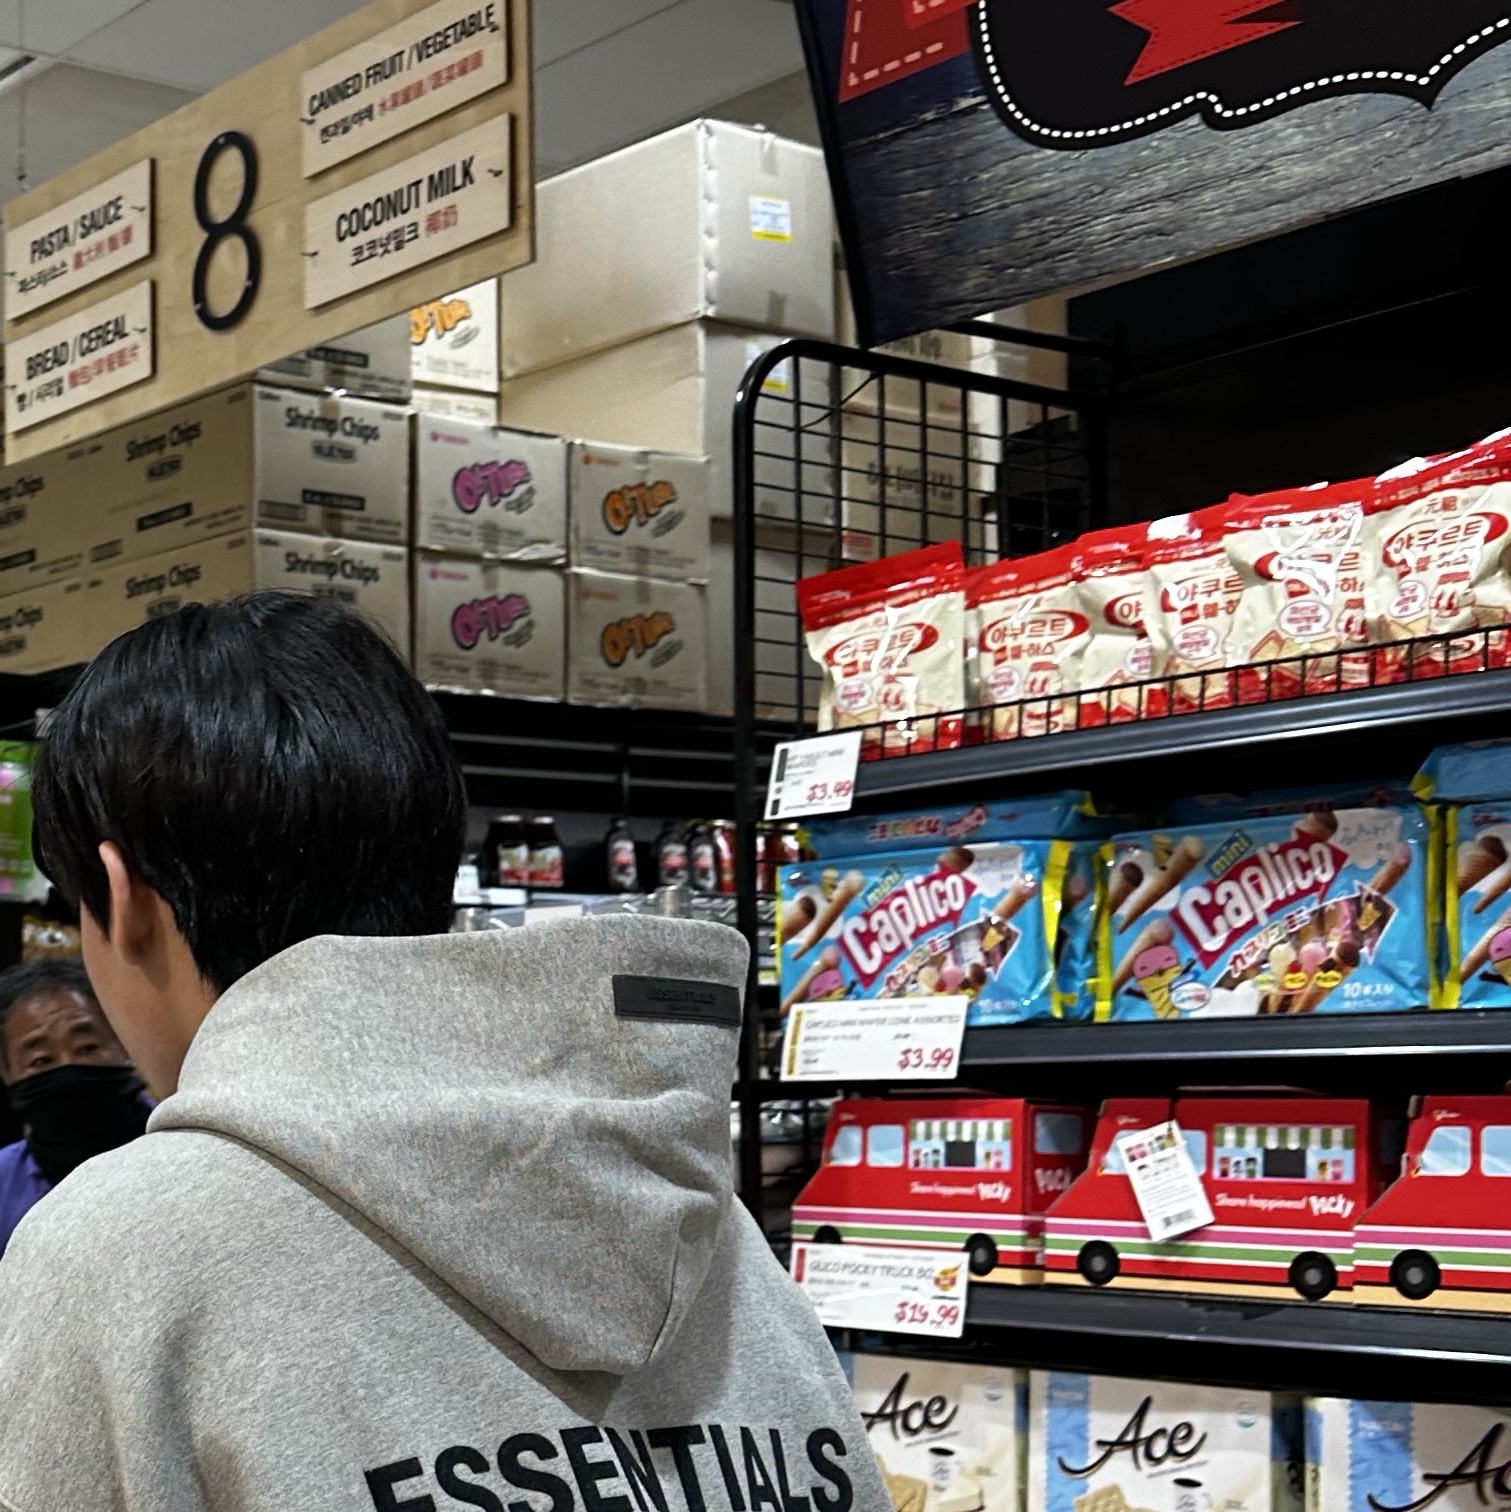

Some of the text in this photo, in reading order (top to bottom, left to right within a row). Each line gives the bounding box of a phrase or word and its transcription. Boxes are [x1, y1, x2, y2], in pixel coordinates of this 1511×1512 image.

[309, 72, 362, 116] CANNED
[365, 50, 406, 88] FRUIT
[416, 3, 495, 63] VEGETABLE
[336, 155, 475, 242] COCONUT MILK
[30, 225, 70, 264] PASTA
[80, 195, 124, 239] SAUCE
[193, 130, 261, 332] 8
[26, 341, 70, 380] BREAD
[80, 314, 129, 357] CEREAL
[126, 420, 202, 463] Shrimp Chips
[285, 407, 380, 444] Shrimp Chips
[14, 474, 45, 498] Chips
[125, 563, 202, 598] Shrimp Chips
[285, 551, 380, 584] Shrimp Chips
[1177, 574, 1244, 602] 야쿠르
[990, 617, 1067, 645] 야쿠르트
[1212, 837, 1251, 874] mini
[842, 872, 967, 976] Caplico
[1178, 842, 1336, 952] Caplico
[1309, 1193, 1355, 1218] Pocky
[861, 1371, 958, 1442] Ace
[1057, 1396, 1207, 1478] Ace
